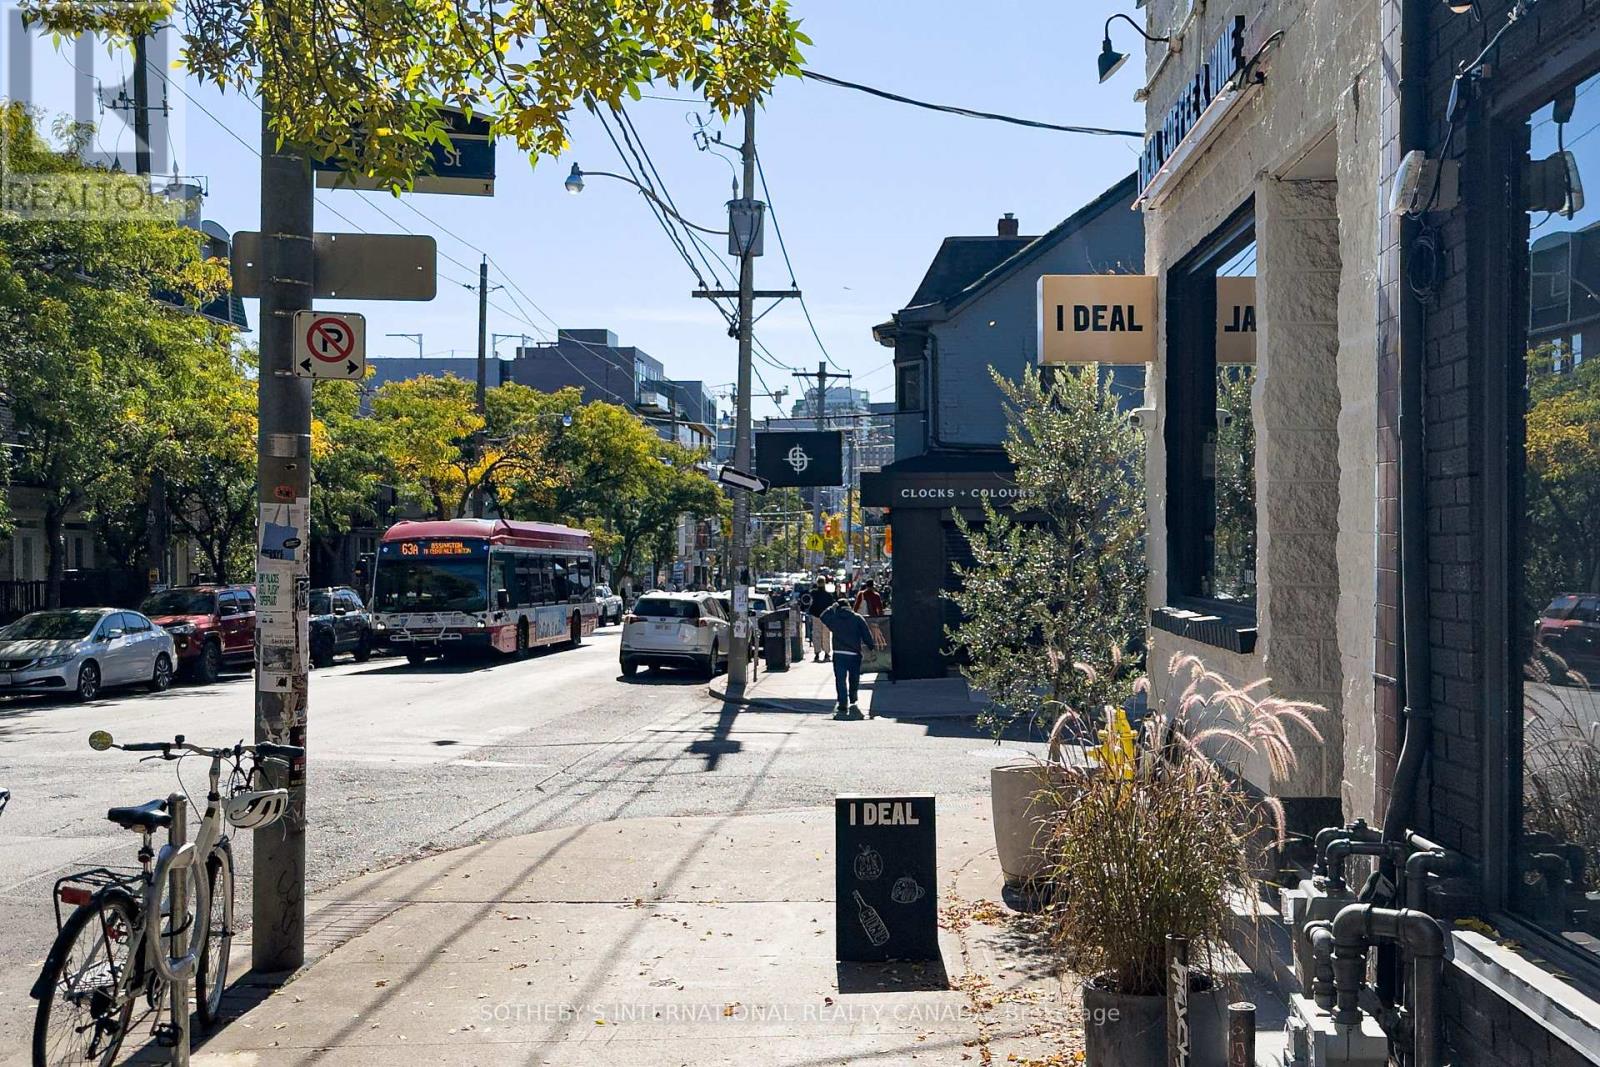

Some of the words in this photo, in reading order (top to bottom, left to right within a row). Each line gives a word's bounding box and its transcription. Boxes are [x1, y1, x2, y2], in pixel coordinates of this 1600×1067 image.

[444, 148, 462, 167] St
[1056, 304, 1064, 332] I
[1073, 304, 1143, 332] DEAL
[901, 488, 955, 498] CLOCKS
[970, 488, 1036, 498] COLOURS
[402, 543, 418, 555] 63A
[849, 802, 857, 826] I
[863, 802, 920, 826] DEAL
